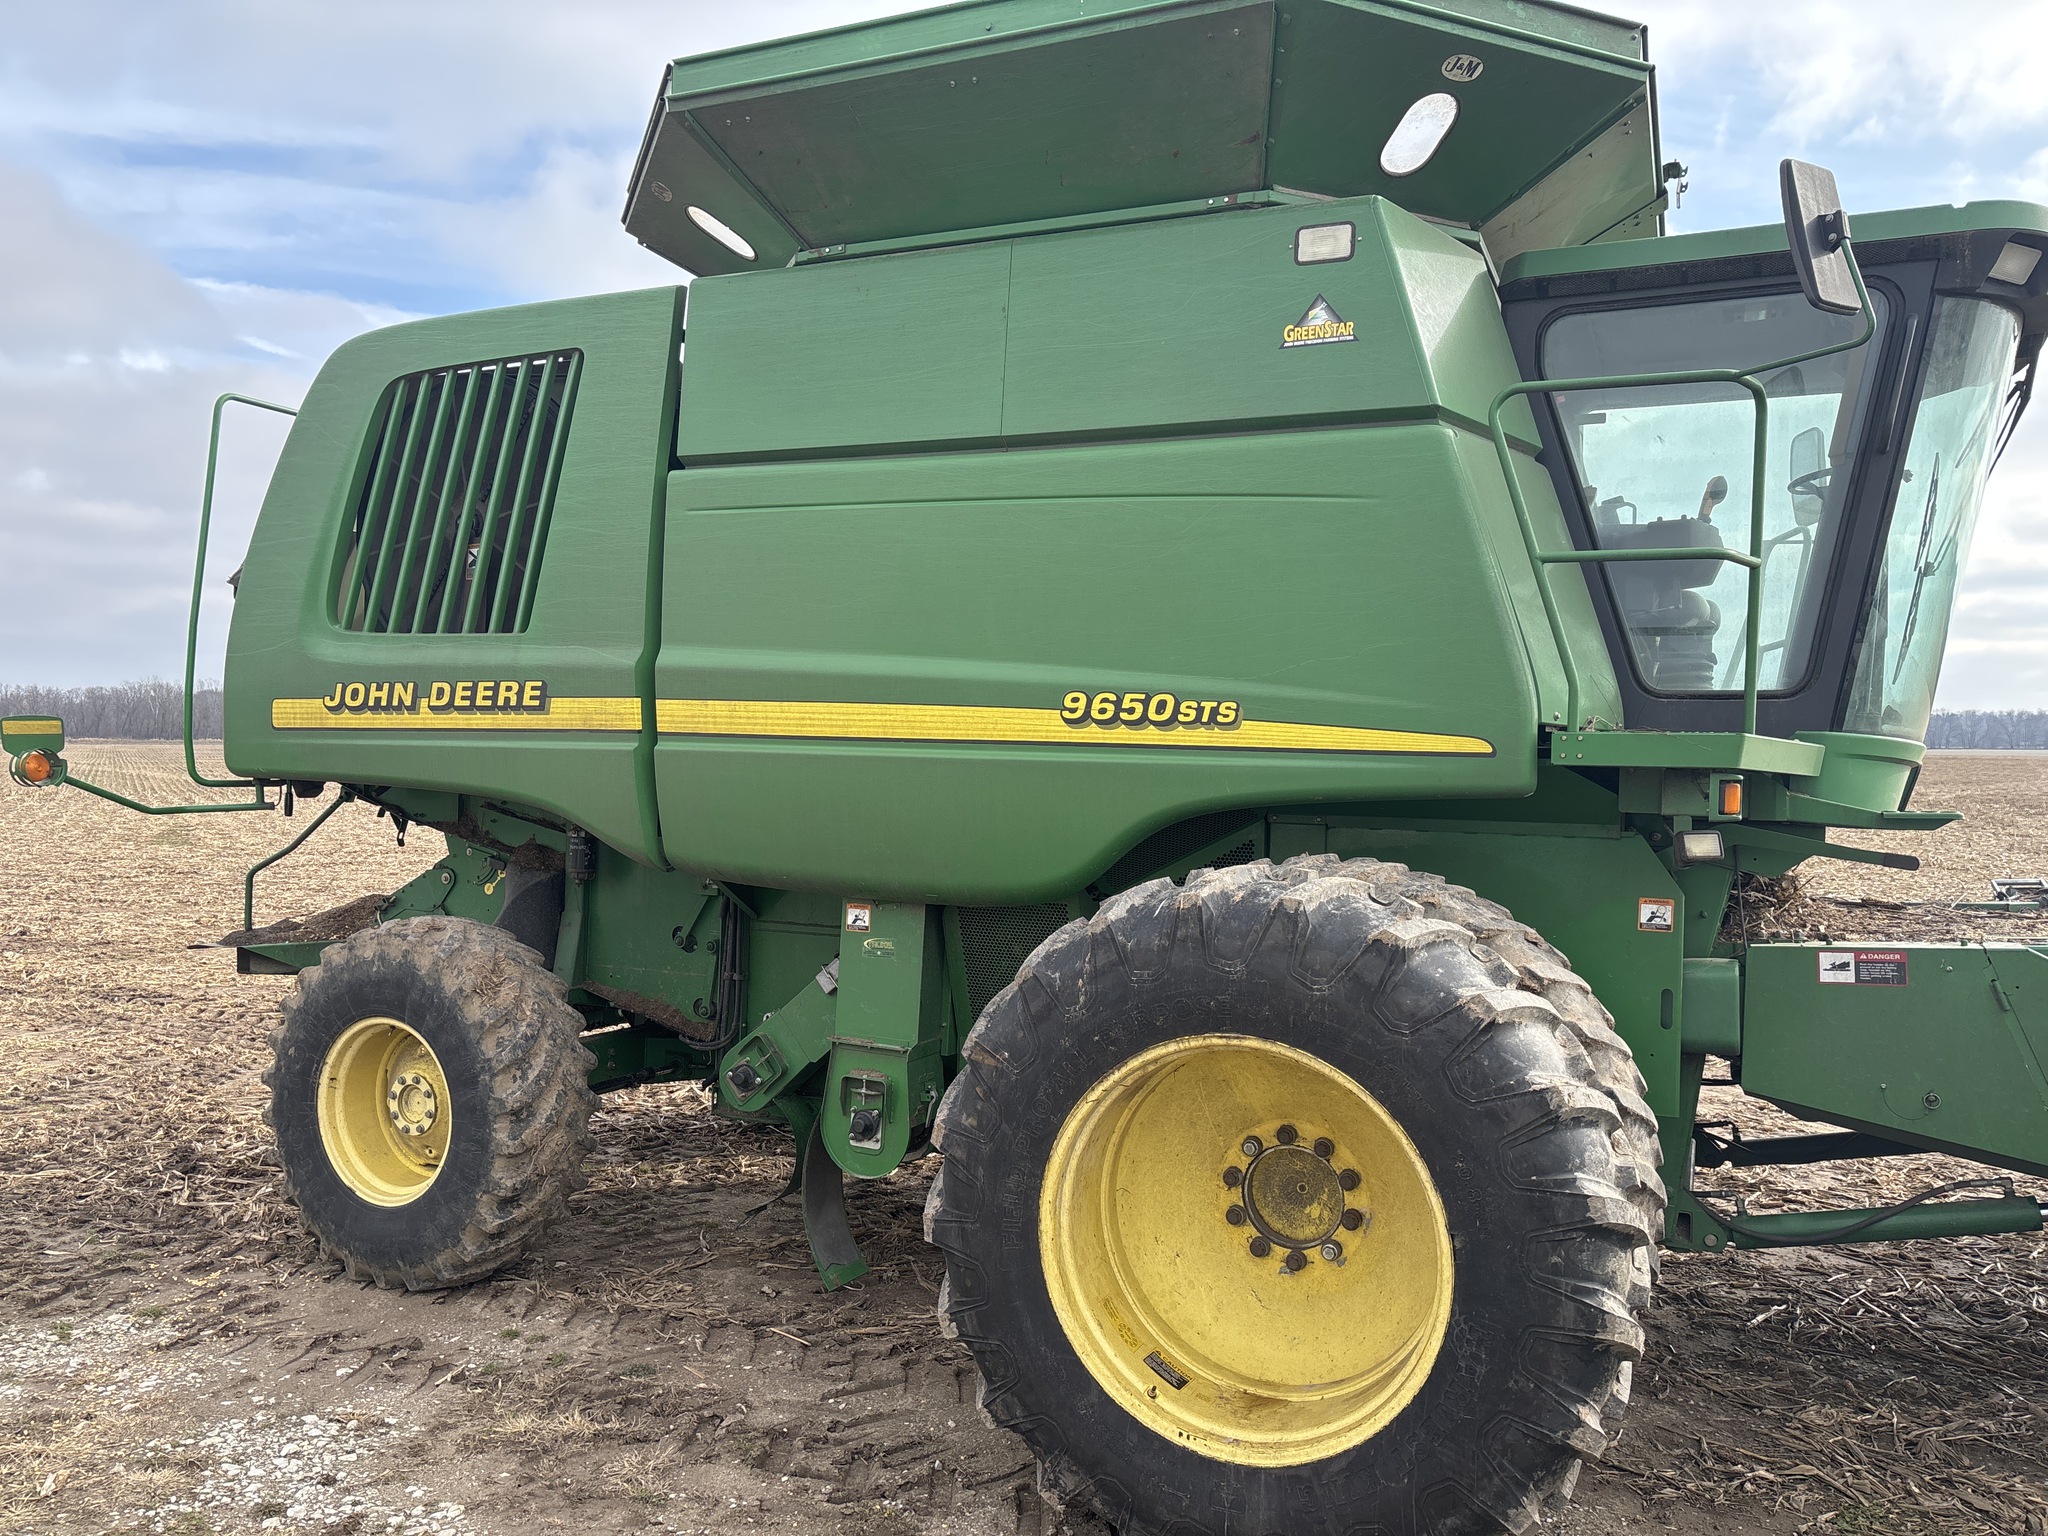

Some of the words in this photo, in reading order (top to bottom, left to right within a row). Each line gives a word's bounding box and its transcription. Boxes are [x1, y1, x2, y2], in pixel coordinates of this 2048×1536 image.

[1444, 56, 1482, 78] J&M
[322, 681, 417, 715] JOHN
[427, 680, 549, 715] DEERE
[1001, 1165, 1026, 1250] FIELD
[1052, 1046, 1097, 1092] ALL
[1162, 1356, 1193, 1380] CAUTION
